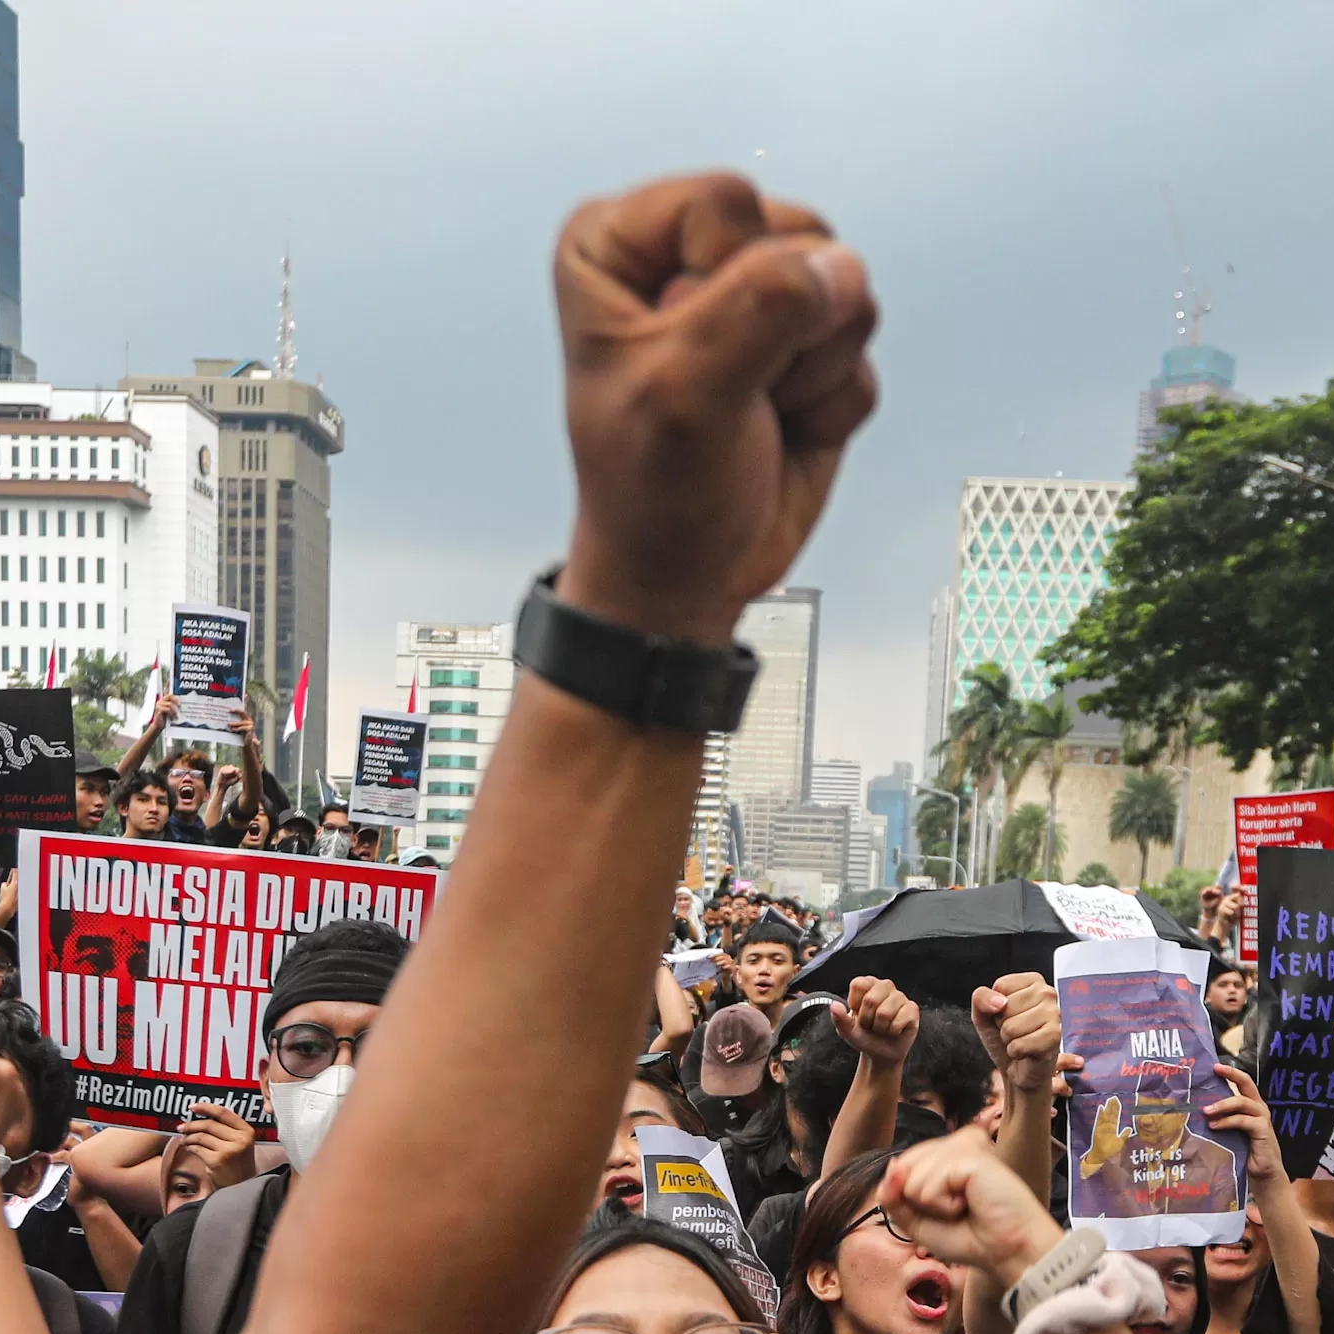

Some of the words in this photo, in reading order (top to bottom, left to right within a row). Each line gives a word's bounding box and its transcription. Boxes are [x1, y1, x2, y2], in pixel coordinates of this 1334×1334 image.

[182, 620, 198, 628] JIKA
[199, 621, 221, 630] AKAR
[221, 624, 237, 633] DARI
[182, 629, 203, 637] DOSA
[203, 631, 233, 641] ADALAH
[181, 646, 203, 654] MAKA
[203, 647, 226, 657] MAHA
[180, 655, 215, 665] PENDOSA
[216, 657, 232, 667] DARI
[180, 663, 208, 672] SEGALA
[180, 672, 214, 682] PENDOSA
[179, 680, 208, 690] ADALAH
[382, 724, 400, 732] AKAR
[400, 726, 415, 734] DARI
[386, 732, 410, 740] ADALAH
[366, 744, 385, 752] MAKA
[385, 746, 404, 754] MAHA
[365, 752, 394, 760] PENDOSA
[394, 754, 409, 762] DARI
[364, 759, 388, 767] SEGALA
[363, 767, 393, 775] PENDOSA
[362, 774, 388, 782] ADALAH
[4, 794, 27, 804] DAN
[1240, 805, 1255, 816] Sita
[1257, 803, 1291, 815] Seluruh
[1293, 801, 1317, 813] Harta
[1240, 819, 1277, 831] Koruptor
[1279, 817, 1303, 827] serta
[1240, 830, 1295, 844] Konglomerat
[49, 853, 246, 927] INDONESIA
[47, 971, 118, 1066] UU
[133, 980, 273, 1082] MIN
[1130, 1028, 1185, 1058] MANA
[1269, 1031, 1332, 1059] ATAS
[1130, 1148, 1162, 1165] this
[1169, 1145, 1183, 1161] is
[1171, 1164, 1186, 1180] of
